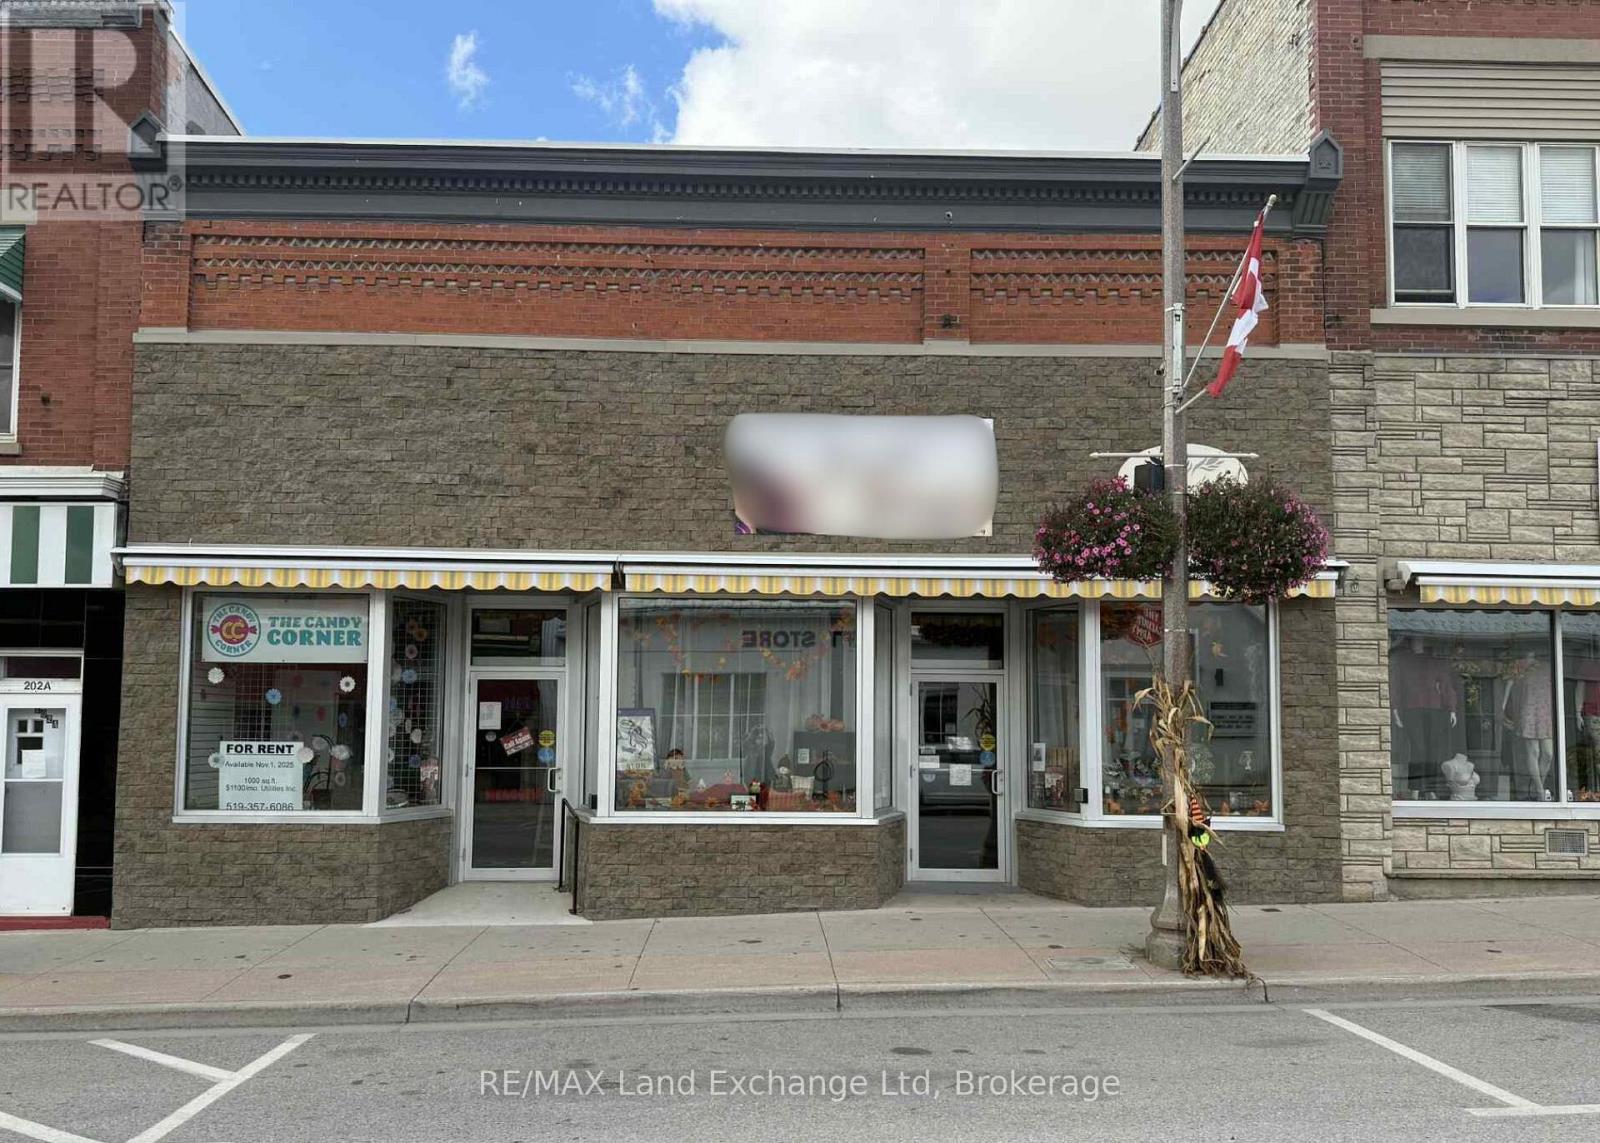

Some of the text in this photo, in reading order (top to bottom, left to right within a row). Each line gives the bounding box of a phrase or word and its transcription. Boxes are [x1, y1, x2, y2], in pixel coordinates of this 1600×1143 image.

[268, 616, 362, 628] THE CANDY
[267, 629, 362, 646] CORNER
[215, 639, 253, 653] CORNER
[24, 681, 51, 690] 202A
[226, 744, 294, 754] FOR RENT
[225, 761, 254, 769] Available
[277, 761, 294, 769] 2025
[244, 777, 260, 785] 1000
